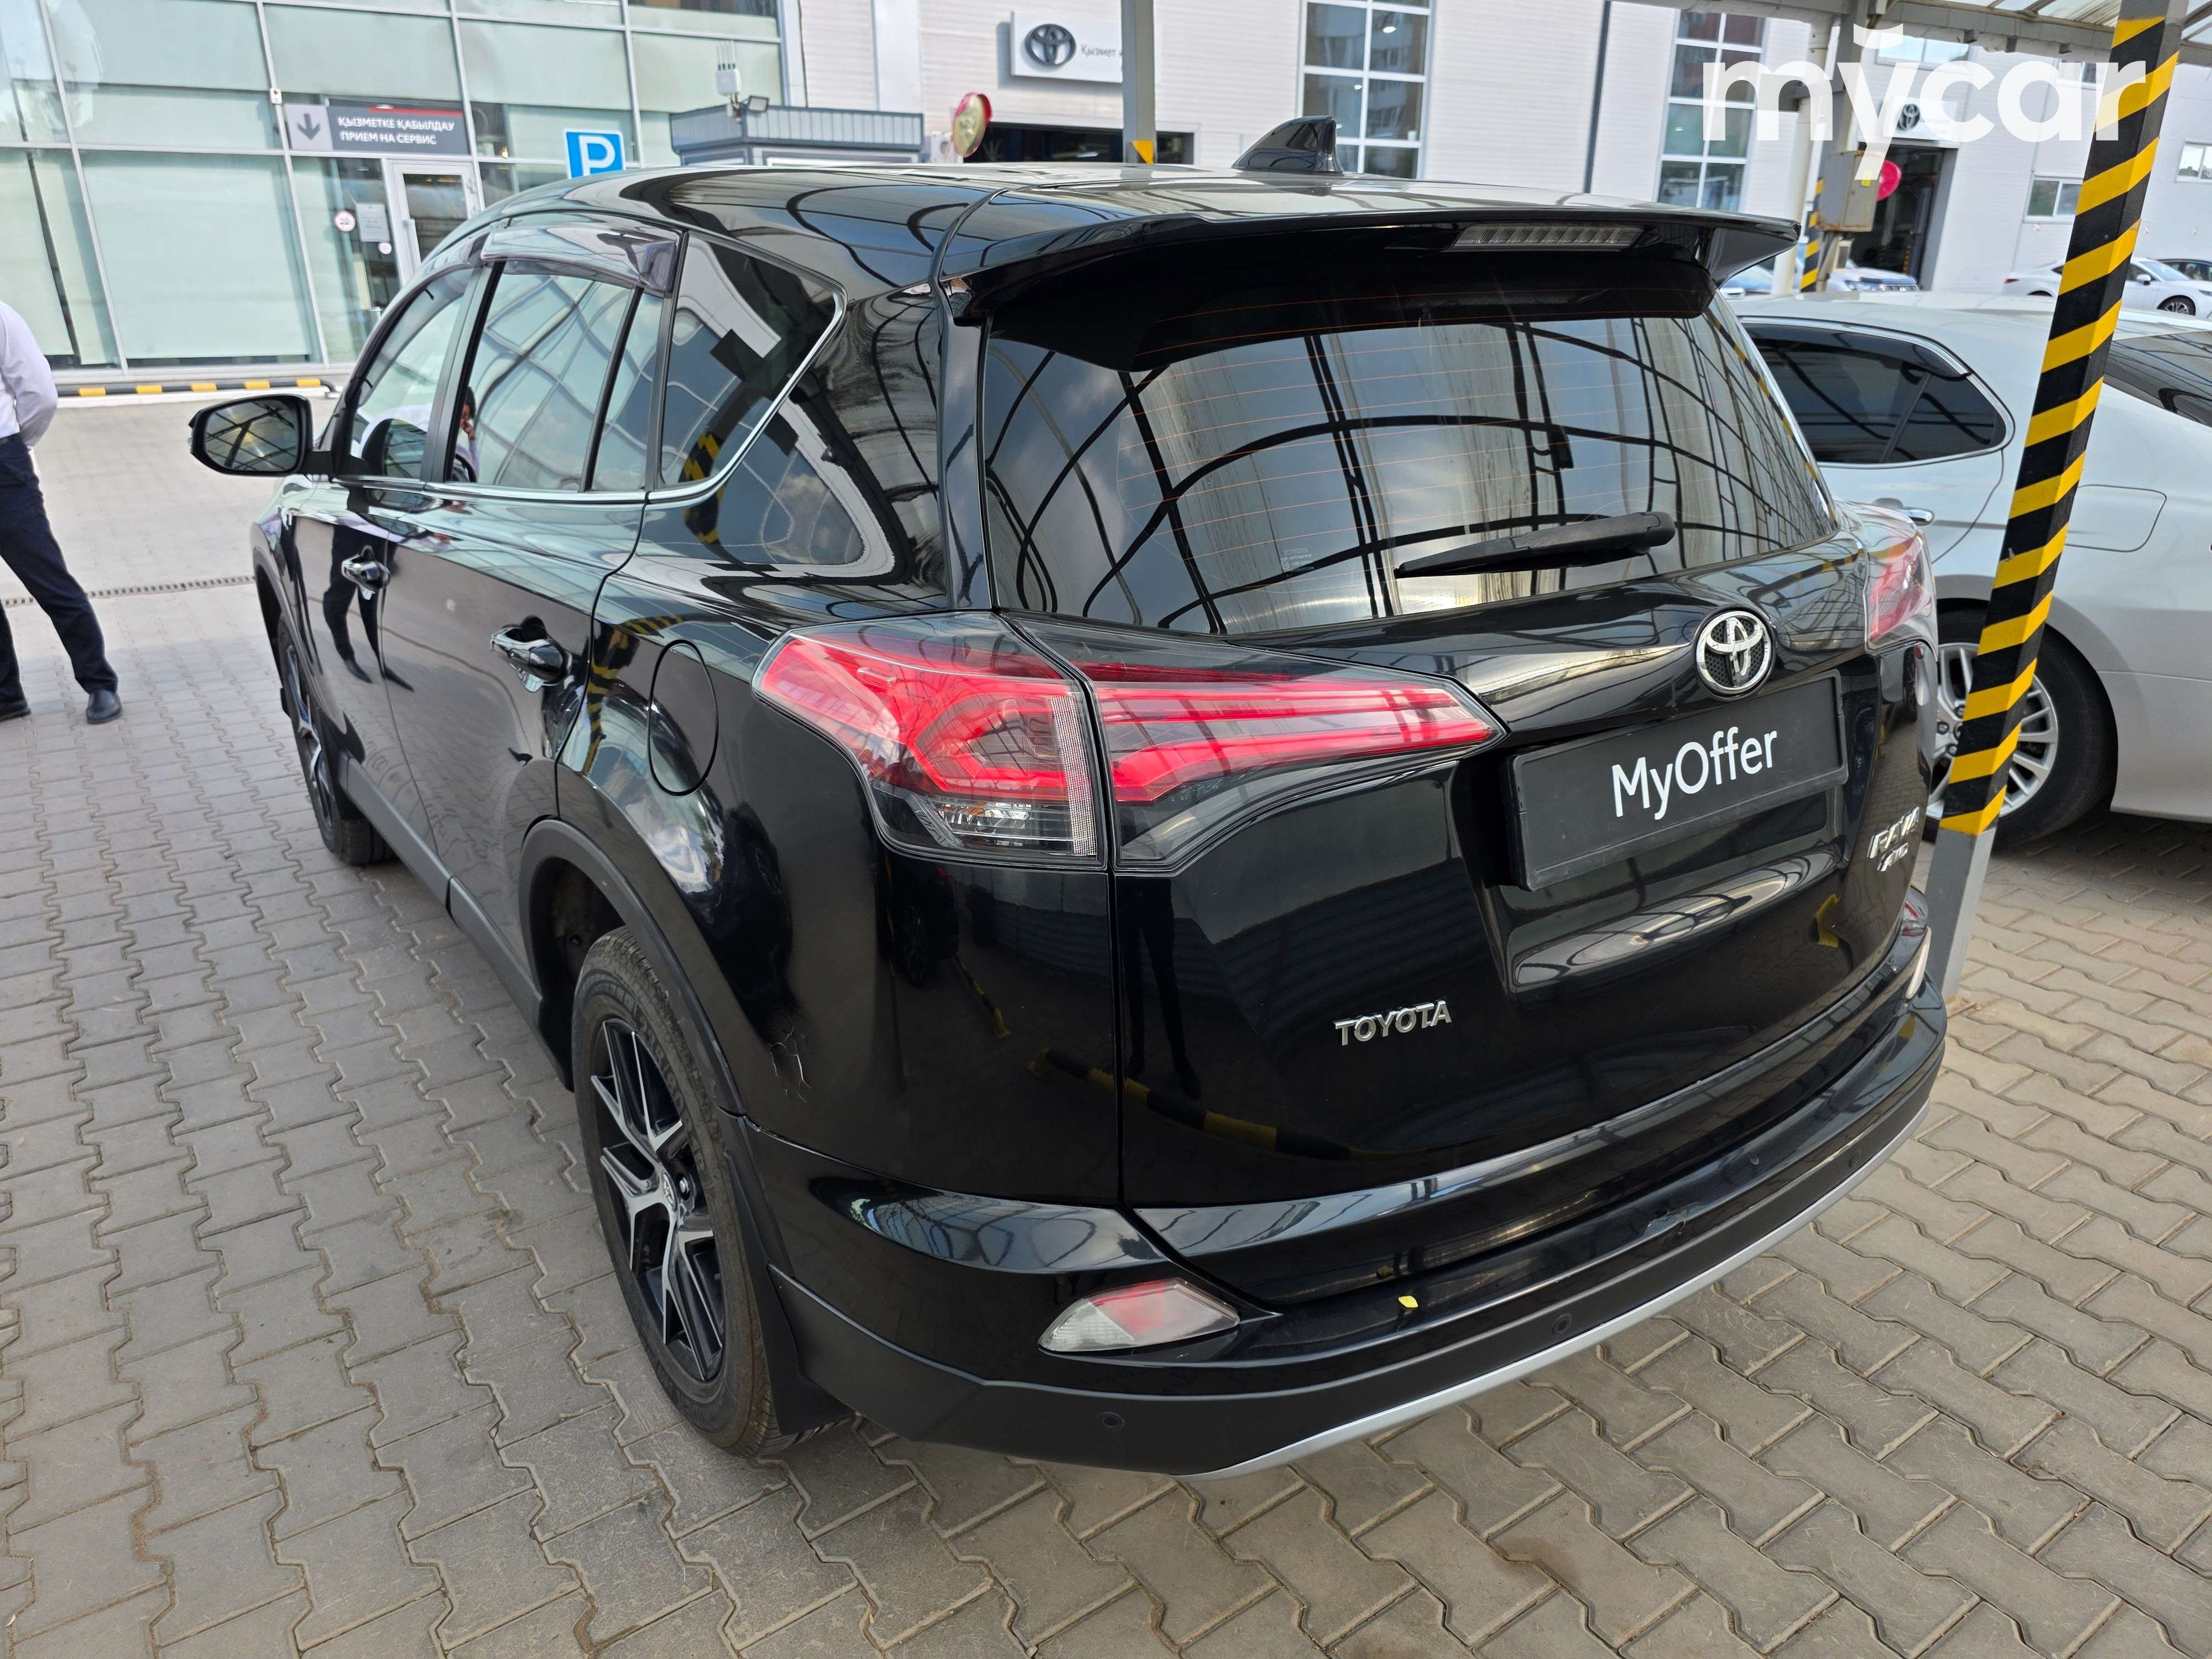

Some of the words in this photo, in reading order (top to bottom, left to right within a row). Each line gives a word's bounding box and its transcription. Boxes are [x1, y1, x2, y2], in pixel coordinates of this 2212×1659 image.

[337, 116, 396, 128] ҚЫЗМЕТКЕ
[397, 118, 455, 132] ҚАБЫЛДАУ
[340, 131, 378, 142] ПРИЕМ
[379, 132, 397, 143] НА
[397, 133, 437, 145] СЕРВИС
[578, 134, 616, 176] P
[1611, 726, 1777, 820] MyOffer
[1332, 999, 1452, 1046] TOYOTA
